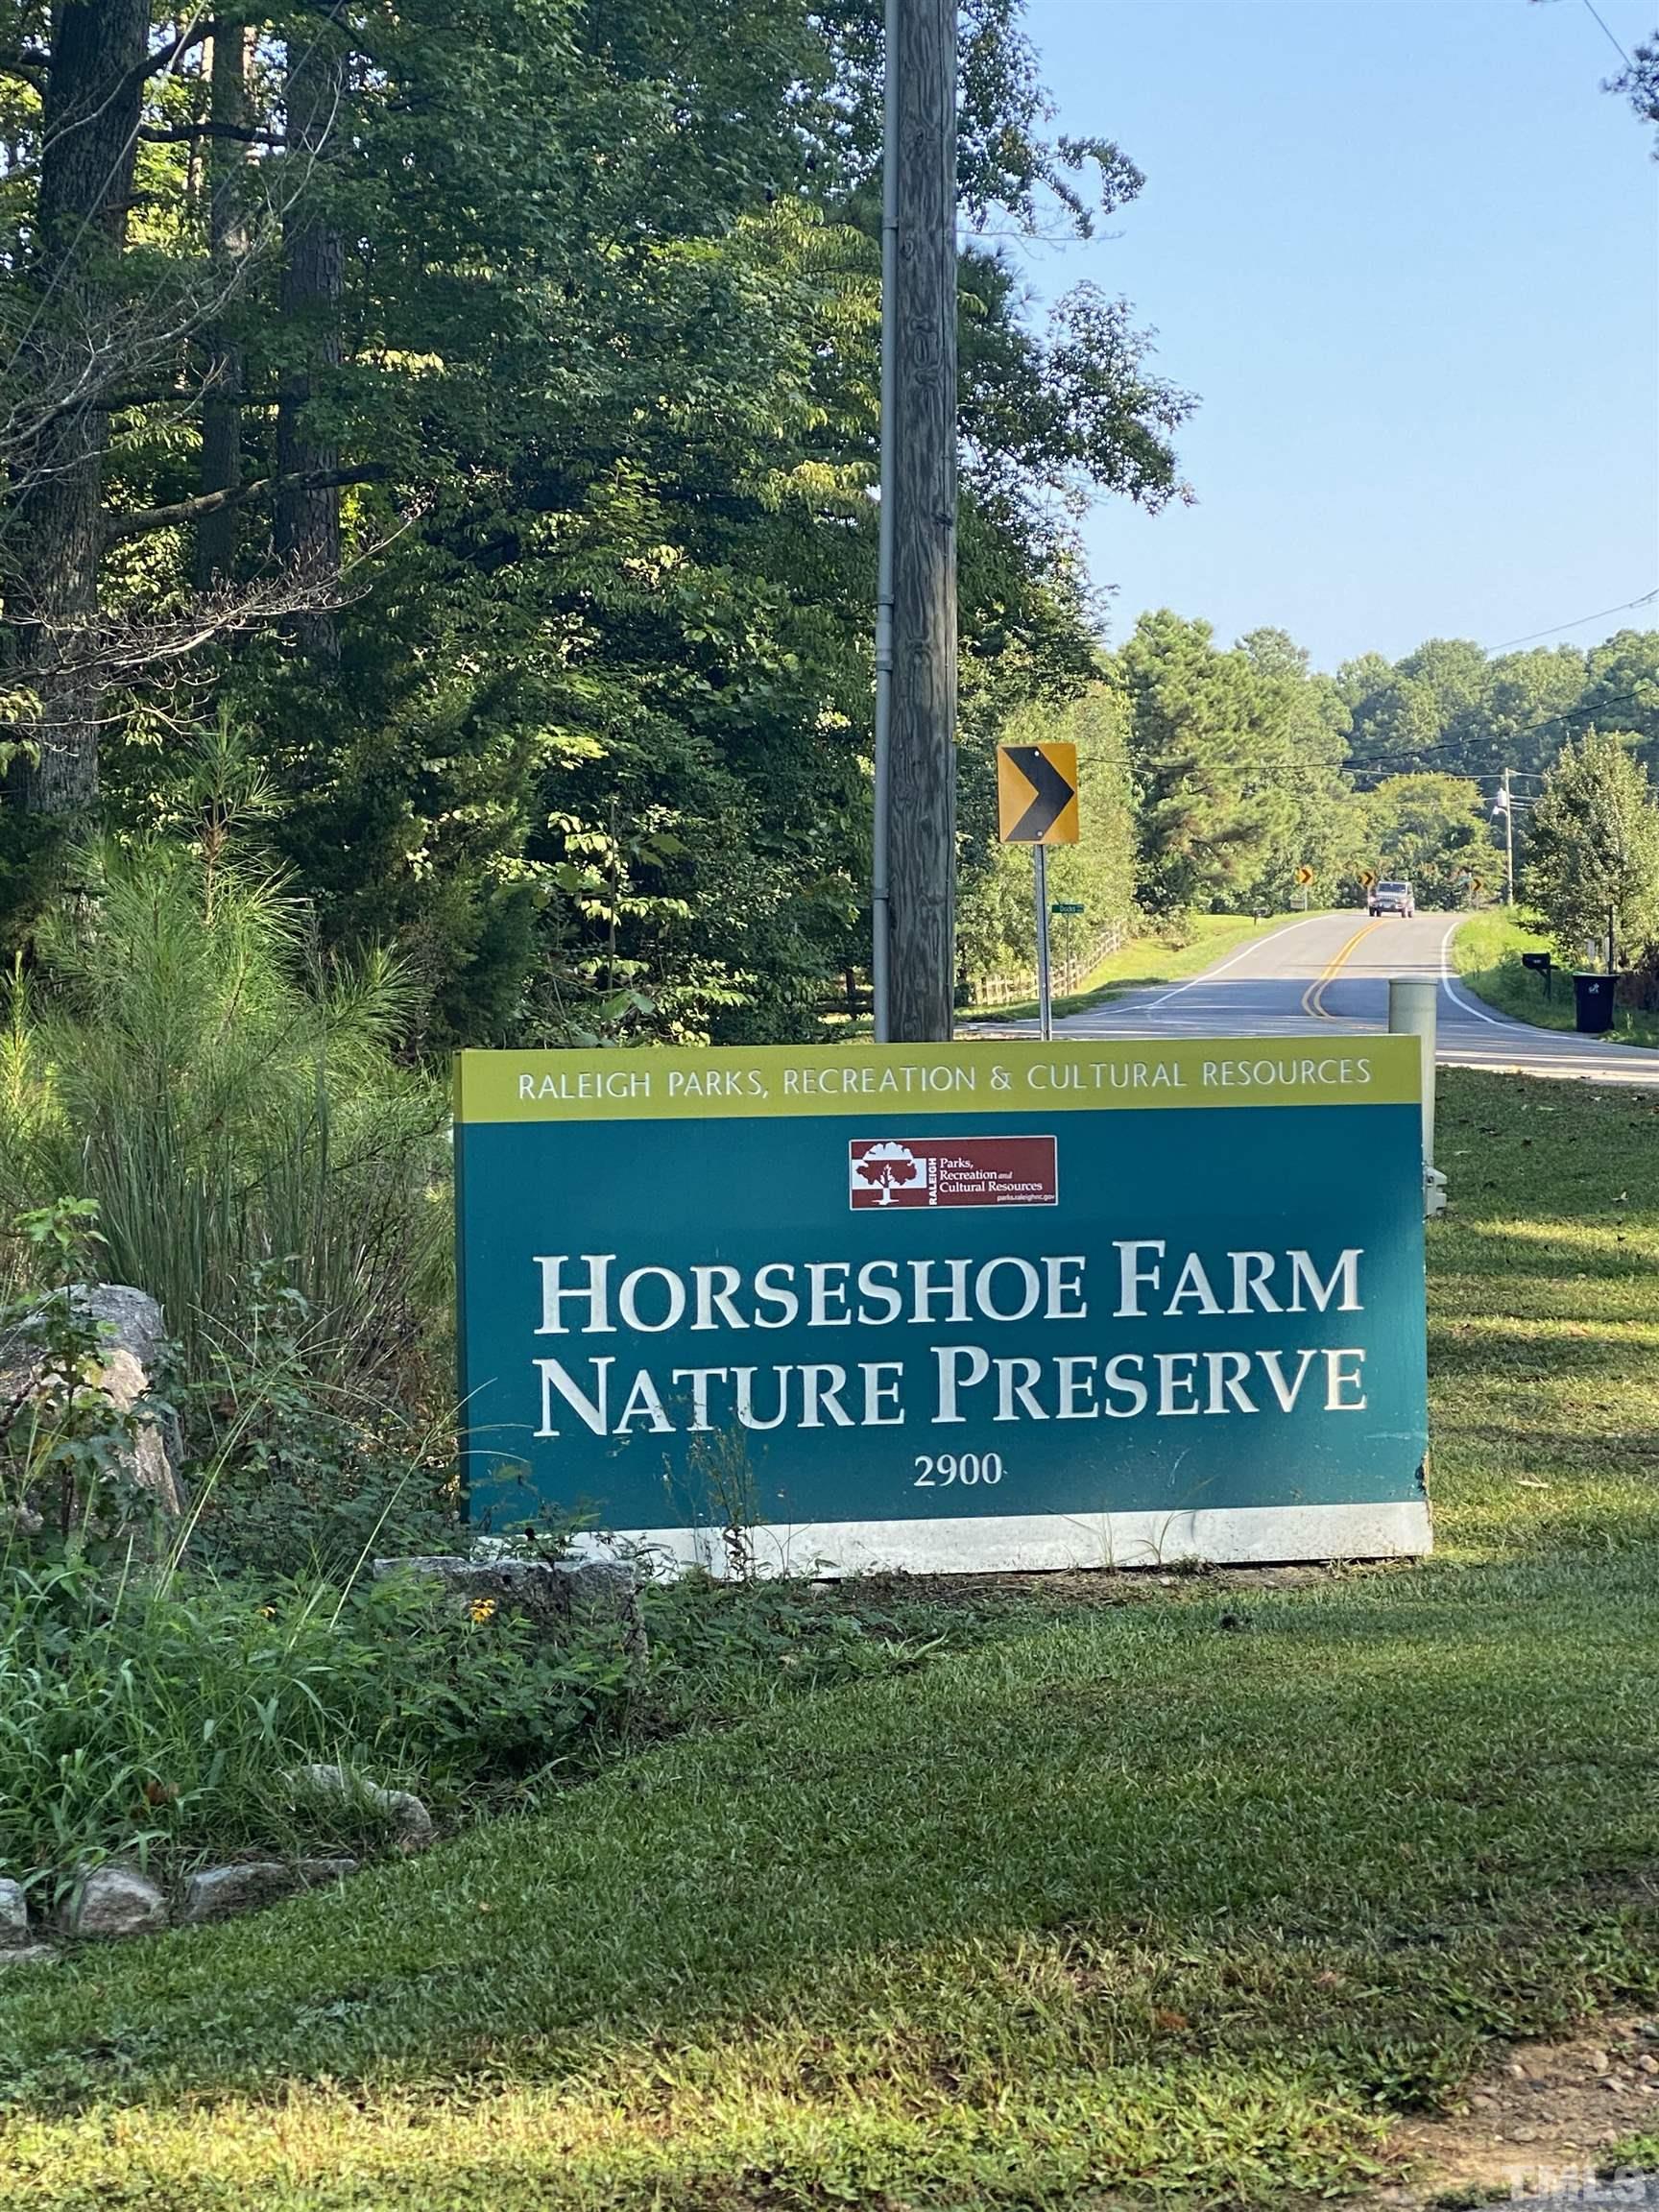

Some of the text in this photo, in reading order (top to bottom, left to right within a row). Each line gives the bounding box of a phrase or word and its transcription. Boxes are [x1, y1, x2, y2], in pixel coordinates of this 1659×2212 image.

[517, 1058, 1371, 1100] RALEIGH PARKS, RECREATION & CULTURAL RESOURCES
[928, 1158, 938, 1206] RALEIGH
[939, 1157, 974, 1169] Parks,
[939, 1169, 1013, 1181] Recreation and
[939, 1180, 1044, 1192] Cultural Resources
[532, 1239, 1365, 1334] HORSESHOE FARM
[532, 1345, 1368, 1437] NATURE PRESERVE
[913, 1452, 1003, 1487] 2900
